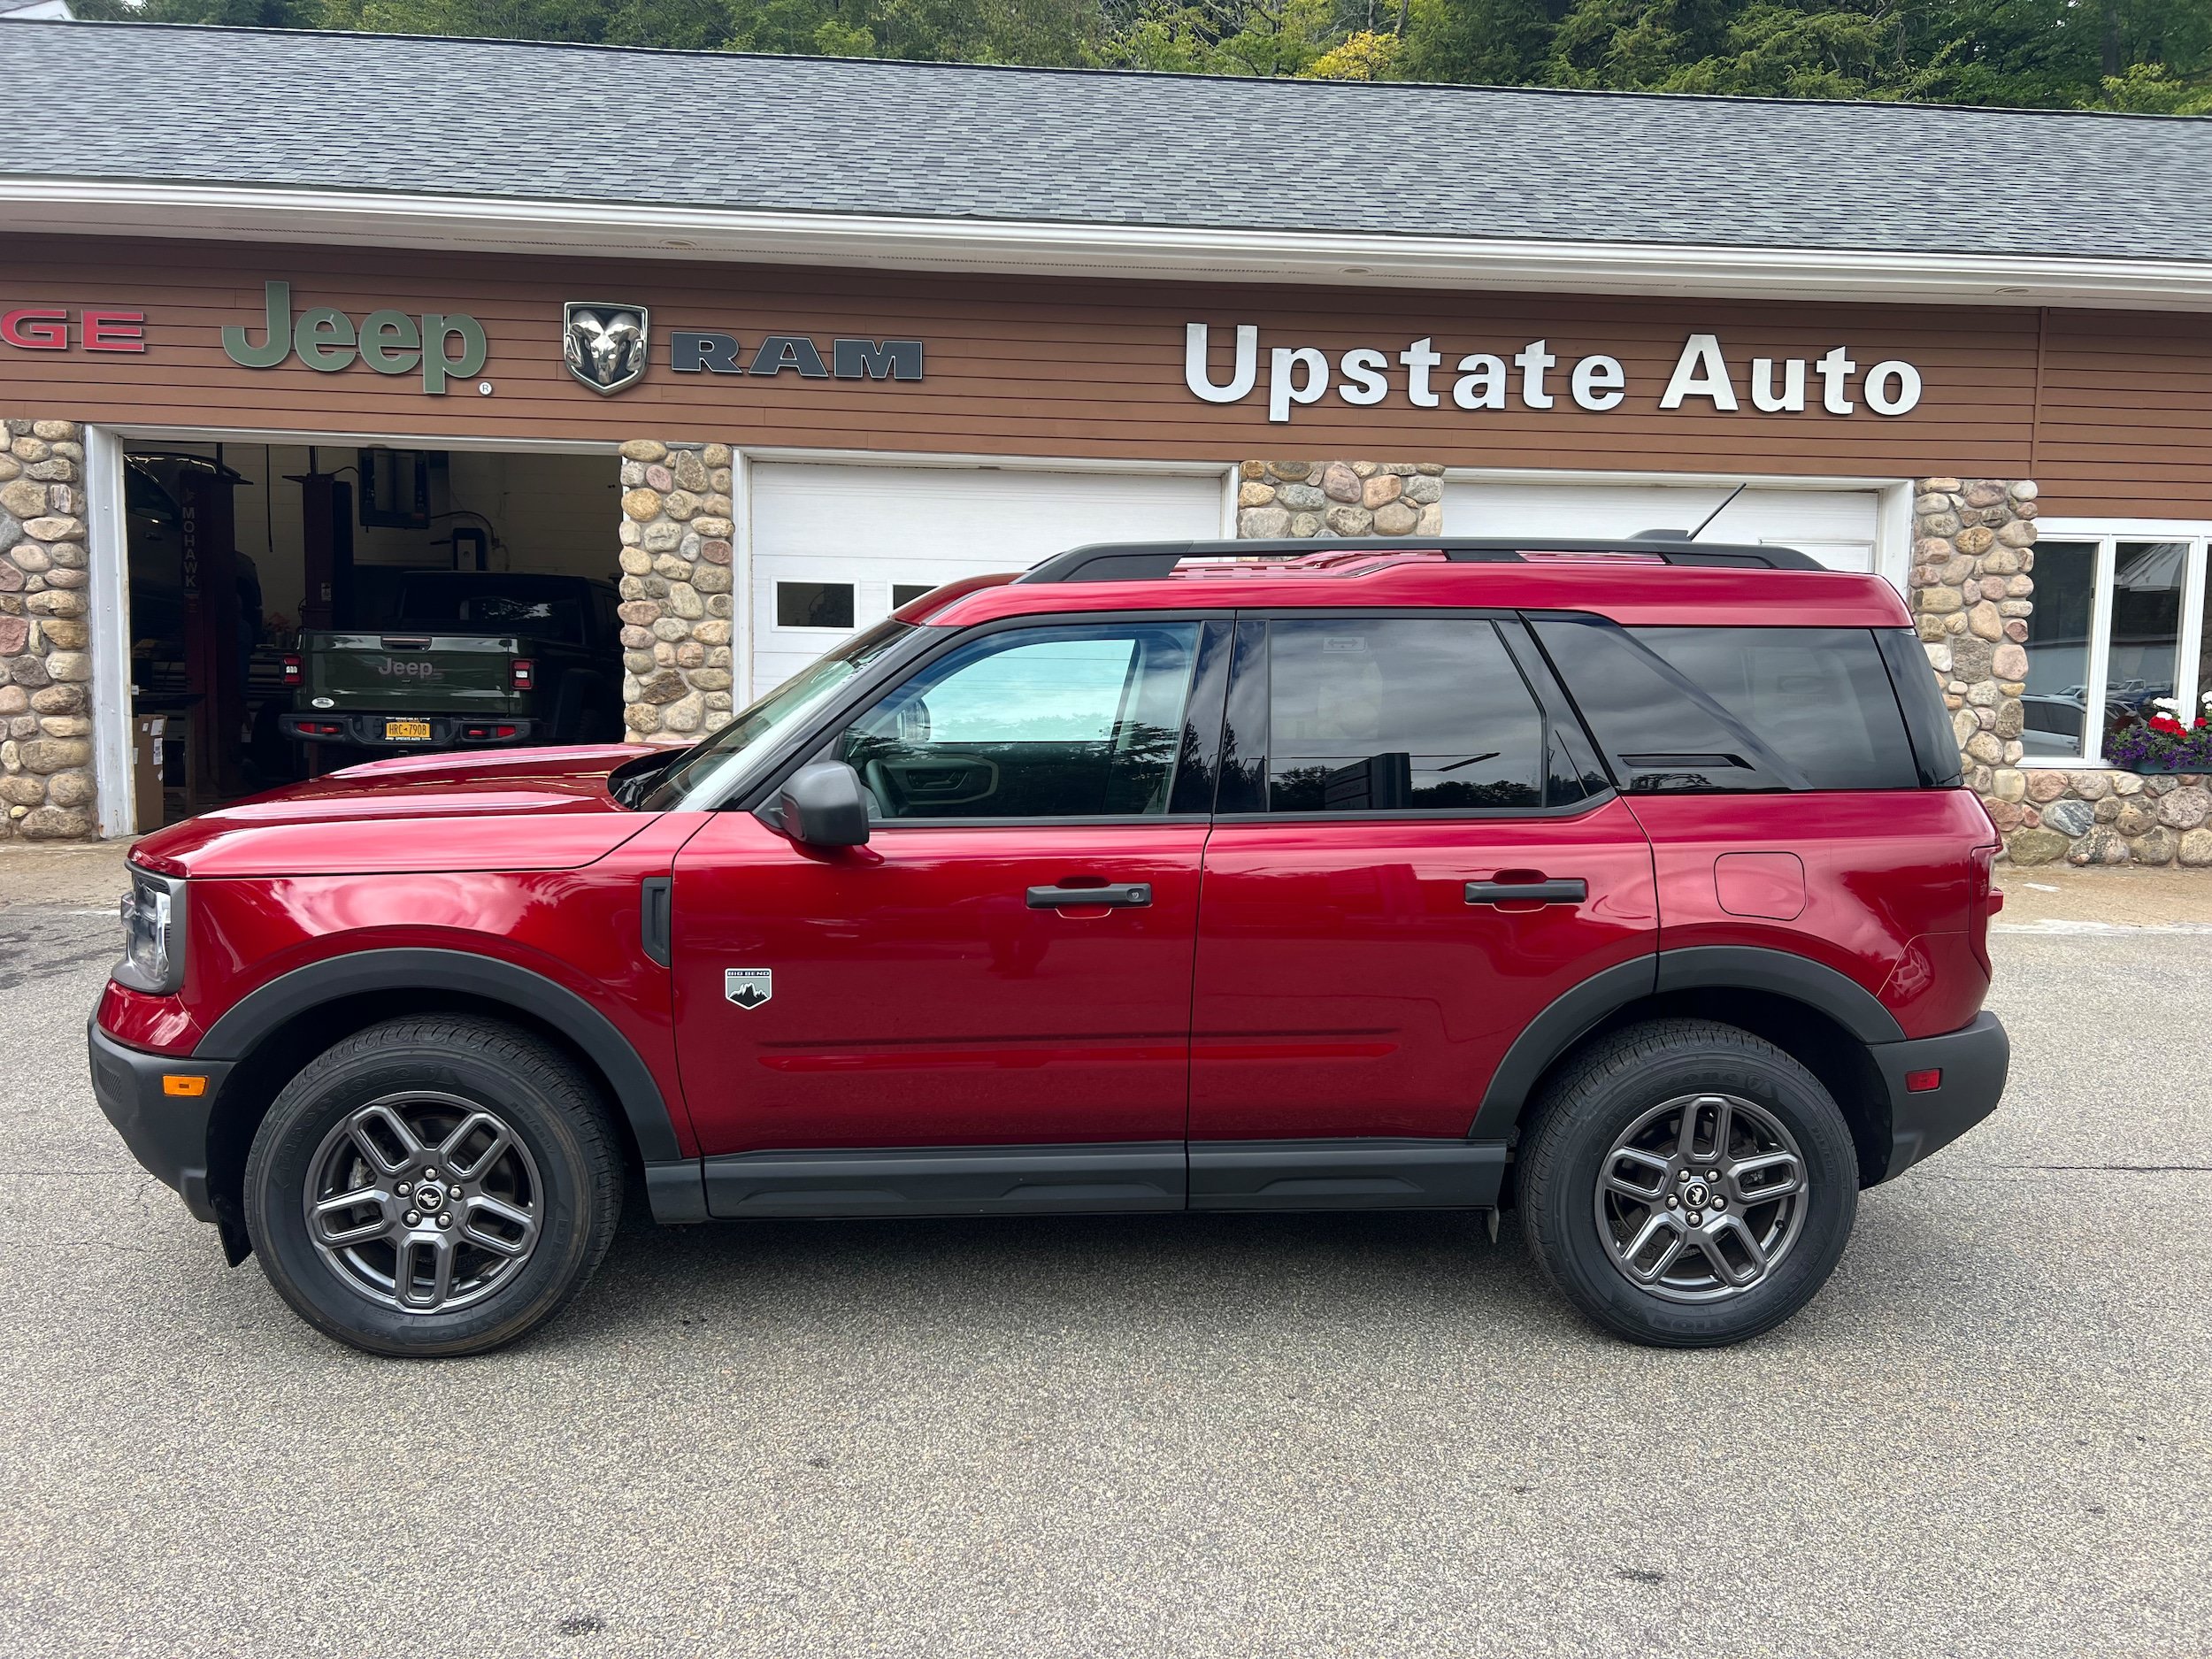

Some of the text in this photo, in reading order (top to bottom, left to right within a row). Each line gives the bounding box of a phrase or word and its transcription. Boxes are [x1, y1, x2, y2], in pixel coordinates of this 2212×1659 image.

[221, 280, 487, 395] Jeep
[671, 332, 923, 380] RAM
[1185, 322, 1922, 423] Upstate Auto
[182, 506, 198, 588] MOHAWK
[378, 657, 434, 679] Jeep
